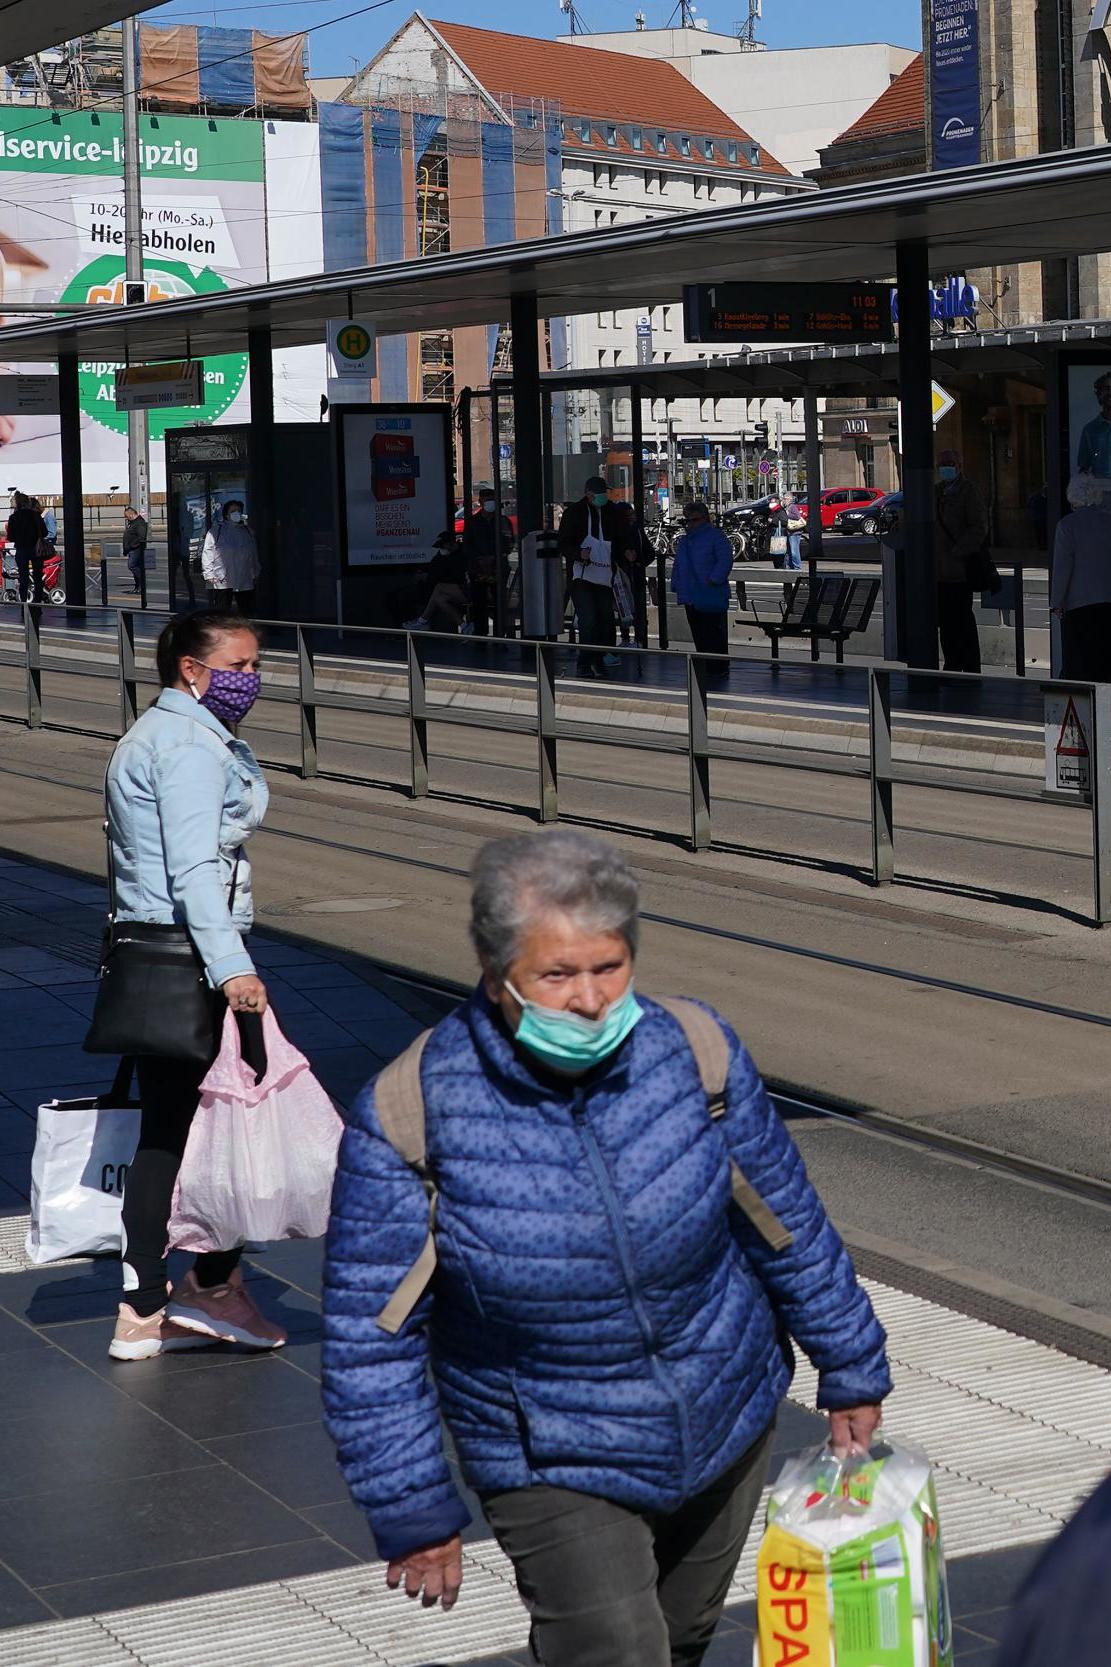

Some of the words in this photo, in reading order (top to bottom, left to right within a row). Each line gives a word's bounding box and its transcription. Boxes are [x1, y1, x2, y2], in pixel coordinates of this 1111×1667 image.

[935, 15, 964, 31] BEGINNEN
[935, 30, 954, 45] JETZT
[158, 210, 214, 229] (Mo.-Sa.)
[141, 229, 215, 254] abholen
[707, 288, 716, 308] 1
[841, 418, 869, 434] ALDI
